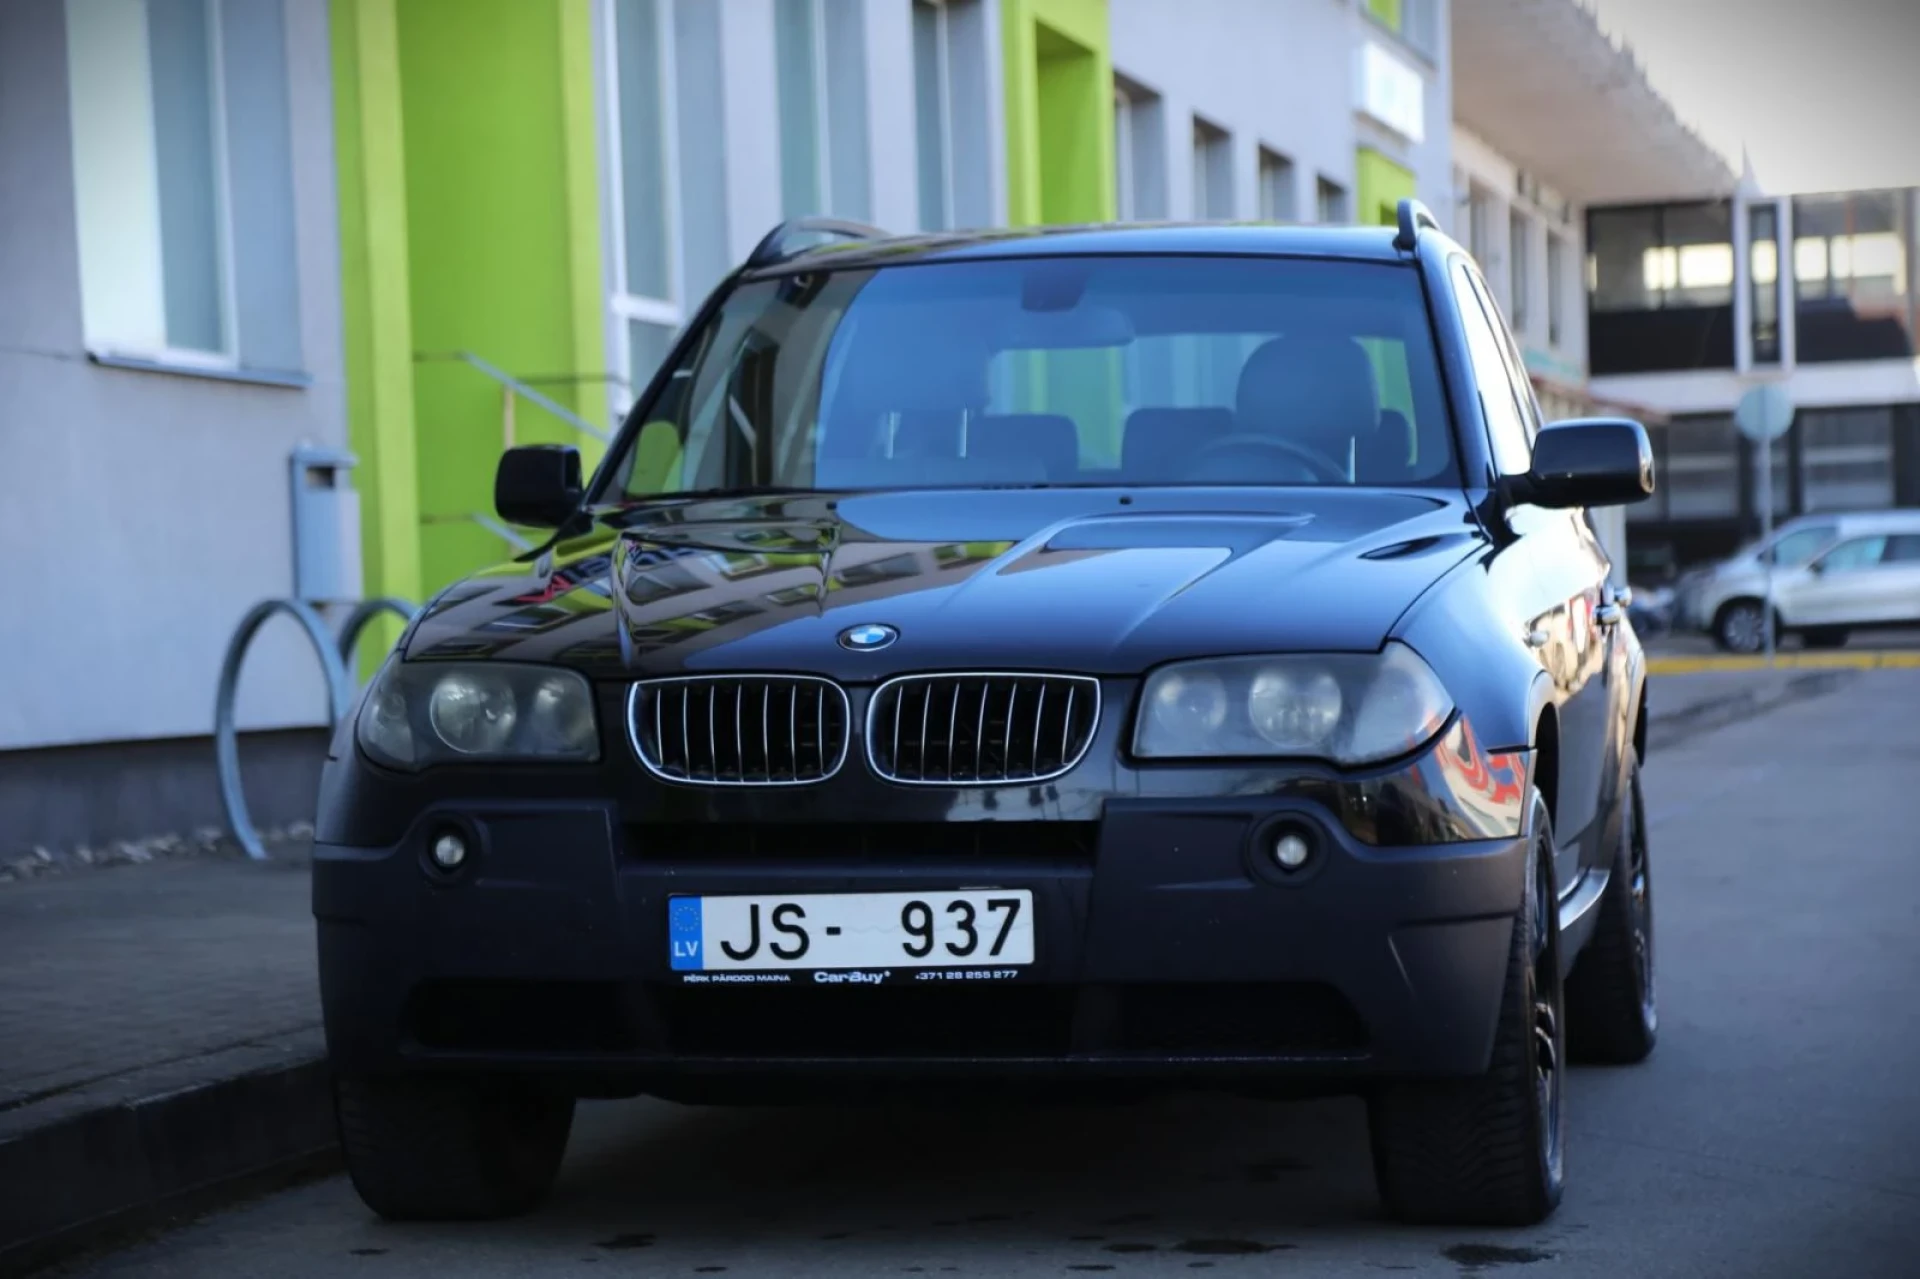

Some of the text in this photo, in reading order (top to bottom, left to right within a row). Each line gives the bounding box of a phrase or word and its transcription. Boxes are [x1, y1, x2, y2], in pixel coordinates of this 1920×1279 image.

[901, 898, 1021, 959] 937
[673, 941, 699, 957] LV
[757, 974, 791, 982] MAINA
[993, 969, 1018, 979] 277
